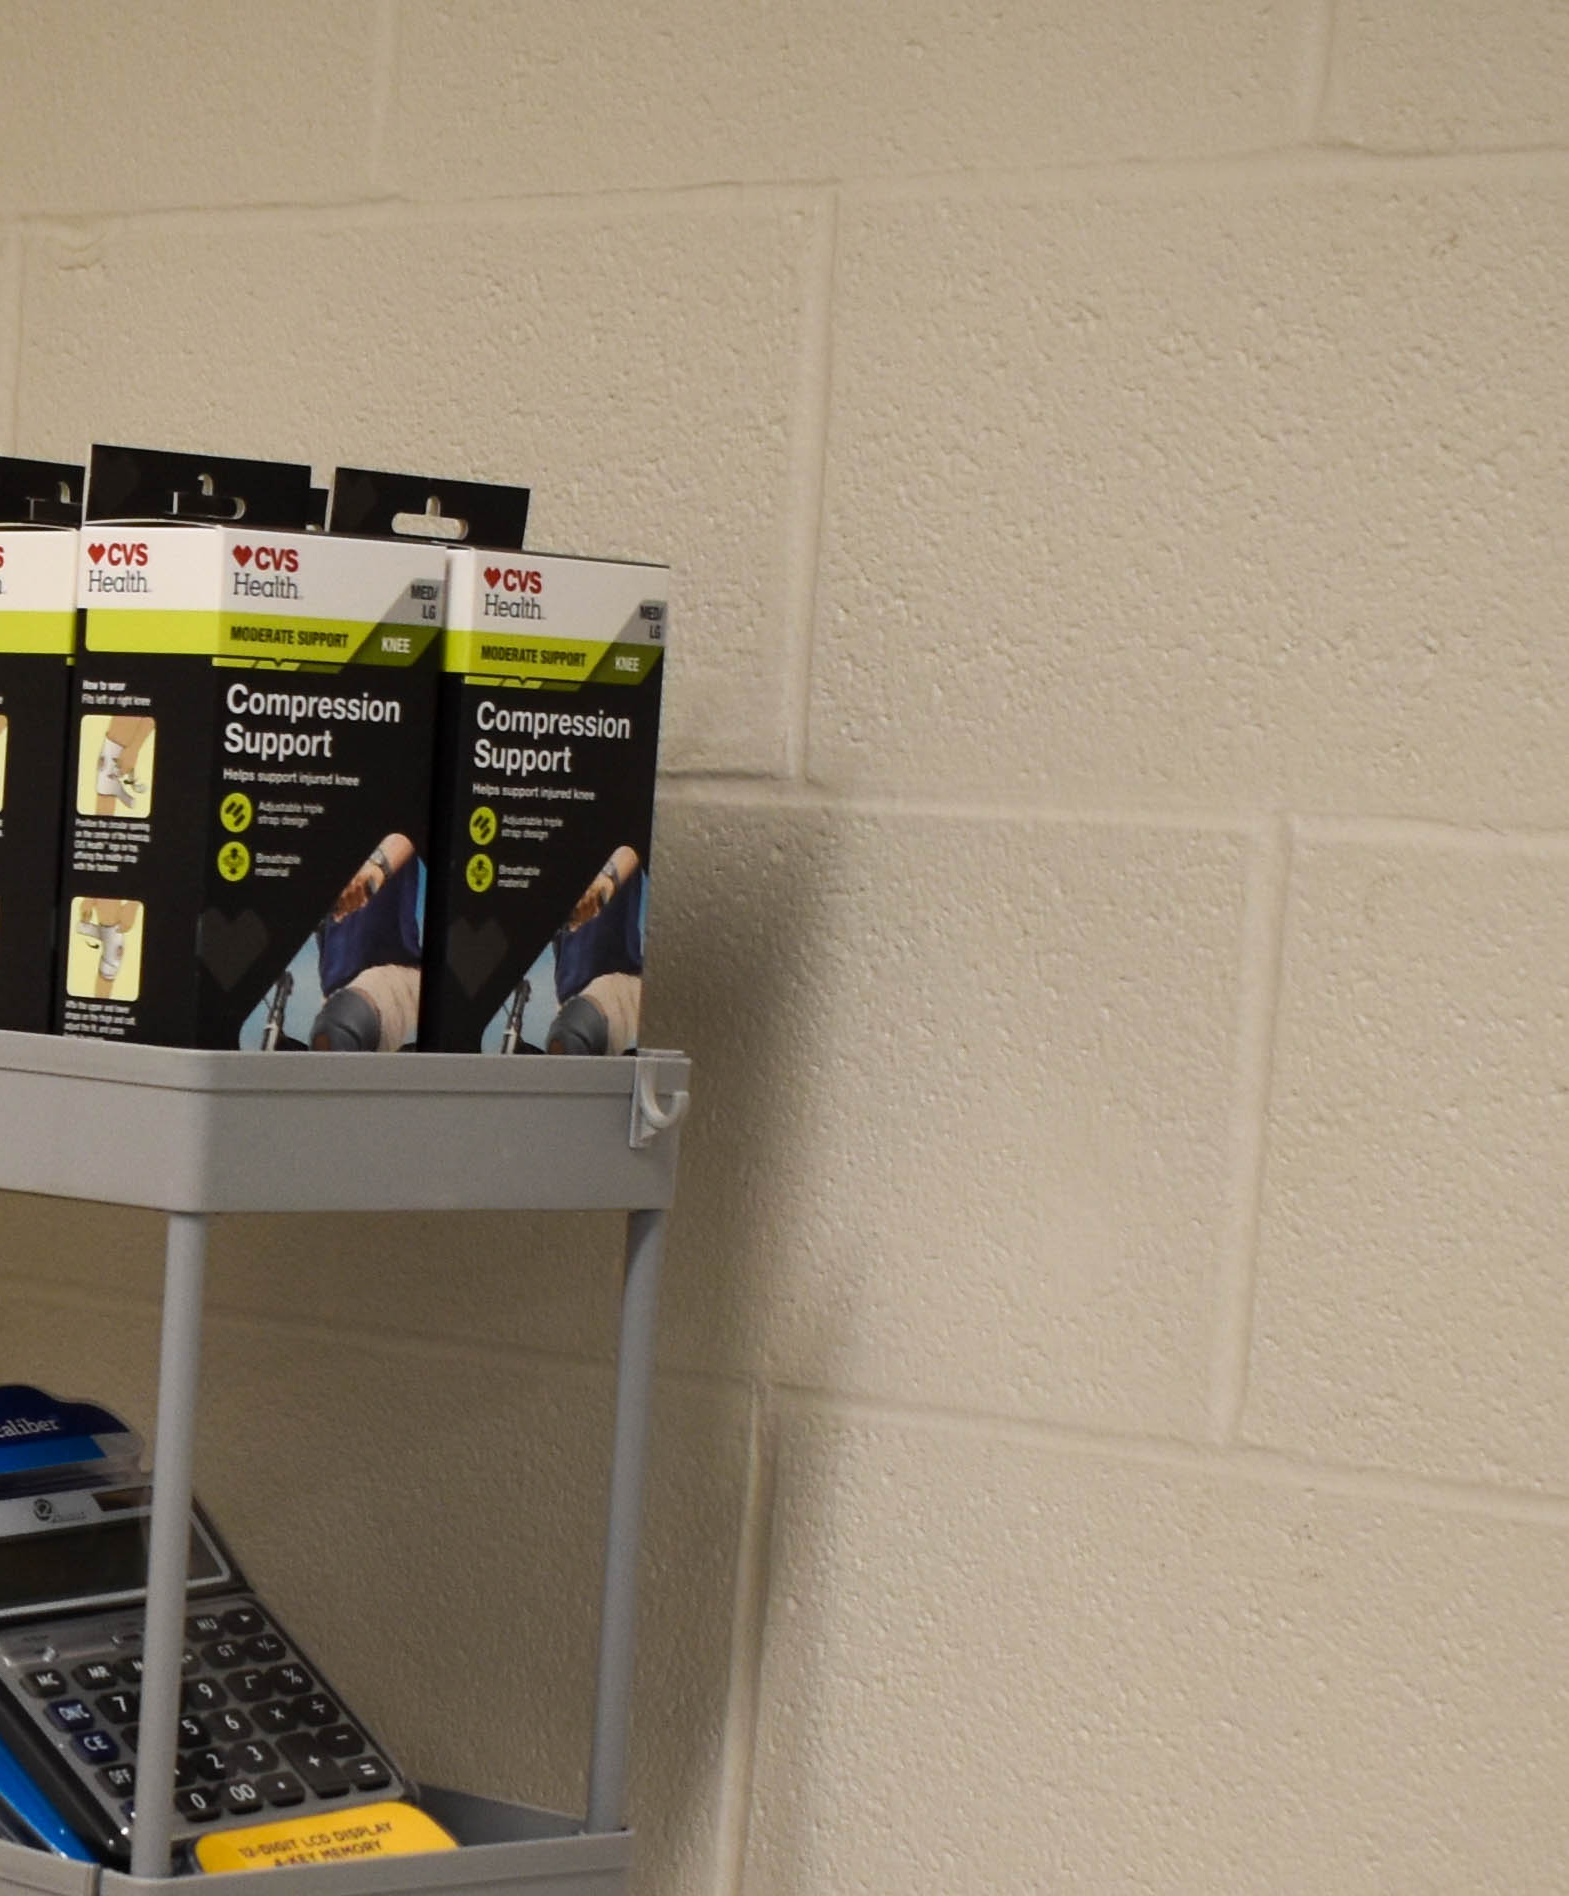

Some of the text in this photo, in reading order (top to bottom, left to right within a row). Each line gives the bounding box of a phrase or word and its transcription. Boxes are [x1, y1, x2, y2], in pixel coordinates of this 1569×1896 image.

[107, 543, 149, 567] CVS
[254, 546, 299, 573] CVS
[87, 570, 149, 593] Health
[232, 572, 299, 600] Health
[503, 568, 542, 594] CVS
[421, 604, 437, 620] LG
[484, 593, 543, 620] Health
[230, 626, 349, 648] MODERATE SUPPORT
[381, 637, 411, 654] KNEE
[481, 645, 587, 668] MODERATE SUPPORT
[614, 655, 641, 673] KNEE
[226, 683, 401, 724] Compression
[476, 701, 631, 740] Compression
[223, 722, 333, 762] Support
[473, 738, 572, 777] Support
[222, 767, 360, 787] Helps support injured knee
[472, 783, 596, 801] Helps support injured knee
[258, 801, 302, 815] Adjustable
[255, 852, 301, 865] Breathable
[198, 1682, 213, 1699] 9
[112, 1696, 127, 1713] 7
[181, 1719, 199, 1736] 5
[224, 1714, 240, 1730] 6
[83, 1735, 108, 1751] CE
[206, 1753, 225, 1769] 2
[247, 1745, 264, 1762] 3
[190, 1792, 206, 1809] 0
[229, 1783, 257, 1802] 00
[332, 1821, 393, 1841] DISPLAY
[321, 1839, 382, 1861] MEMORY
